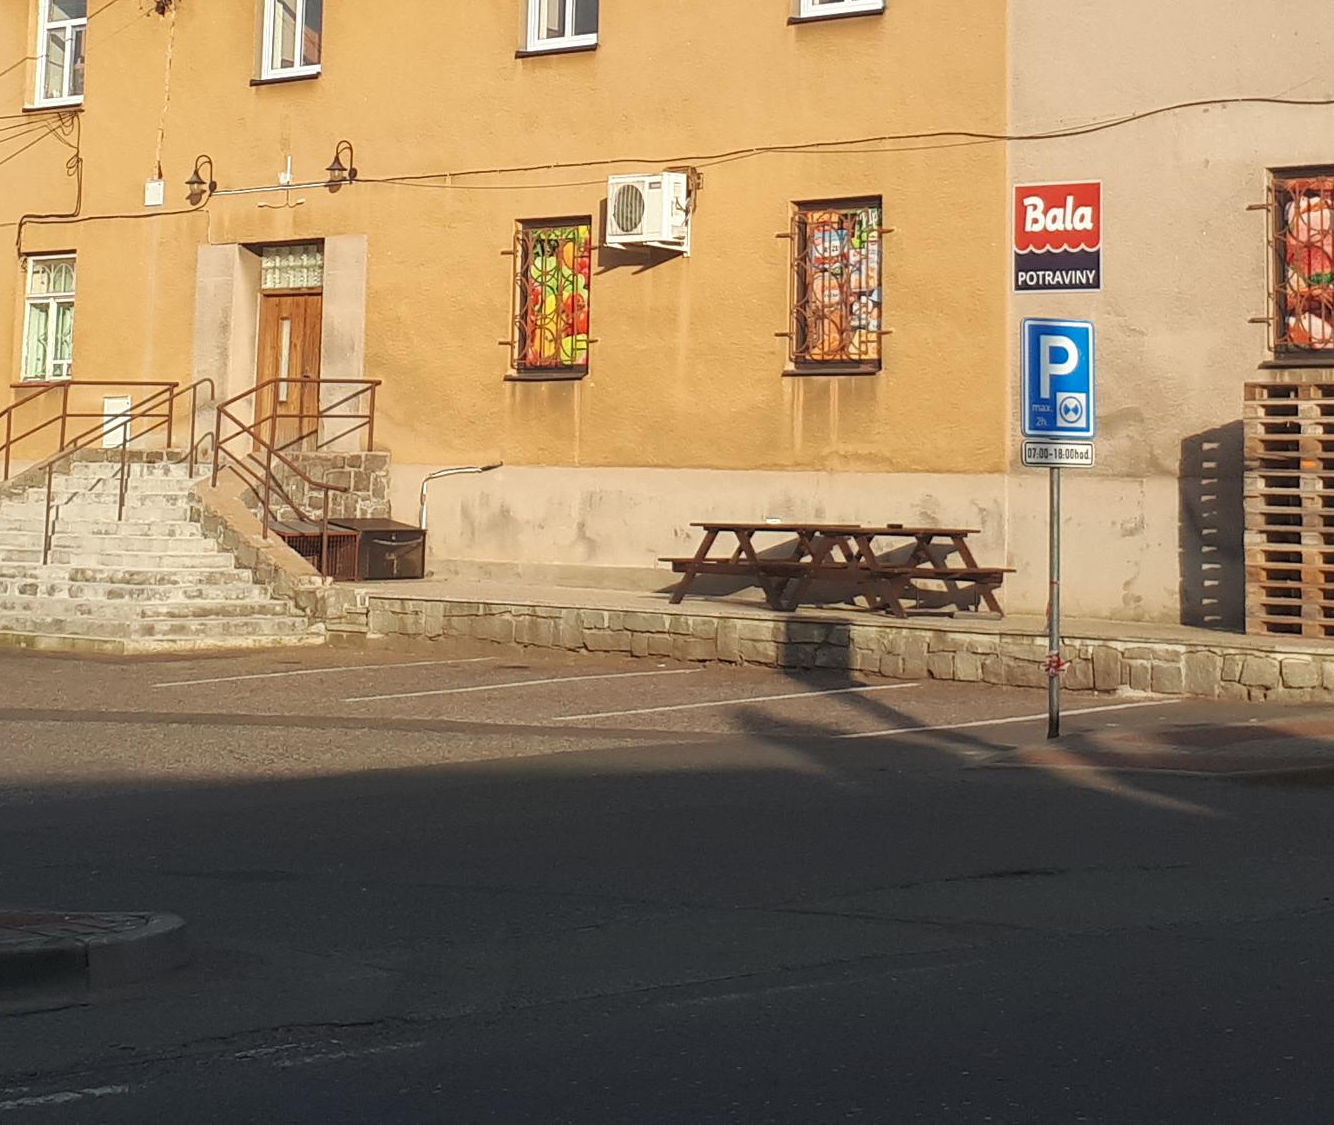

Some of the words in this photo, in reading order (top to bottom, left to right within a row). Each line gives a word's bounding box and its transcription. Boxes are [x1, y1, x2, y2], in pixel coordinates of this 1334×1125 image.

[1023, 195, 1093, 232] Bala
[1018, 270, 1095, 286] POTRAVINY
[1040, 334, 1078, 398] P
